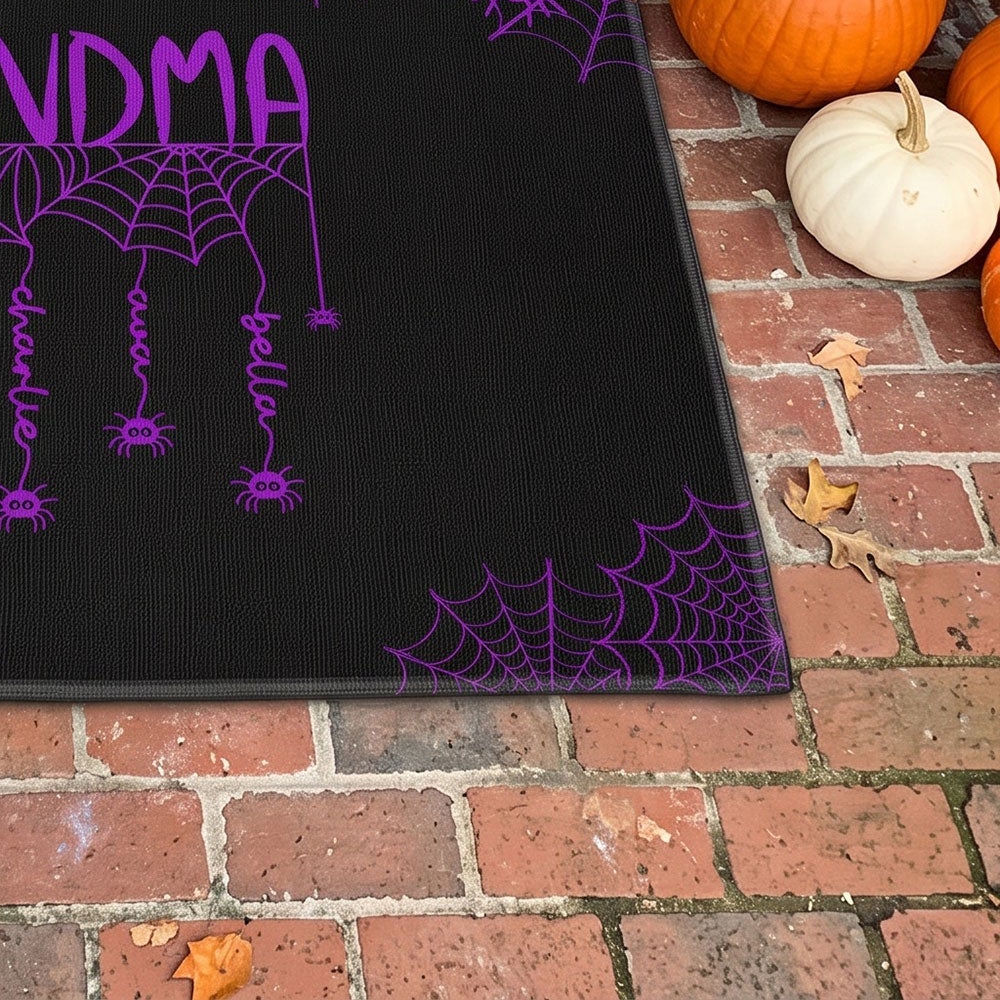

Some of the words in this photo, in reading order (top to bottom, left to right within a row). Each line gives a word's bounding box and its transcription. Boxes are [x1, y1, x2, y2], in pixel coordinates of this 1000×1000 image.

[8, 285, 50, 444] charlie
[127, 288, 151, 373] ava
[240, 311, 288, 424] bella
